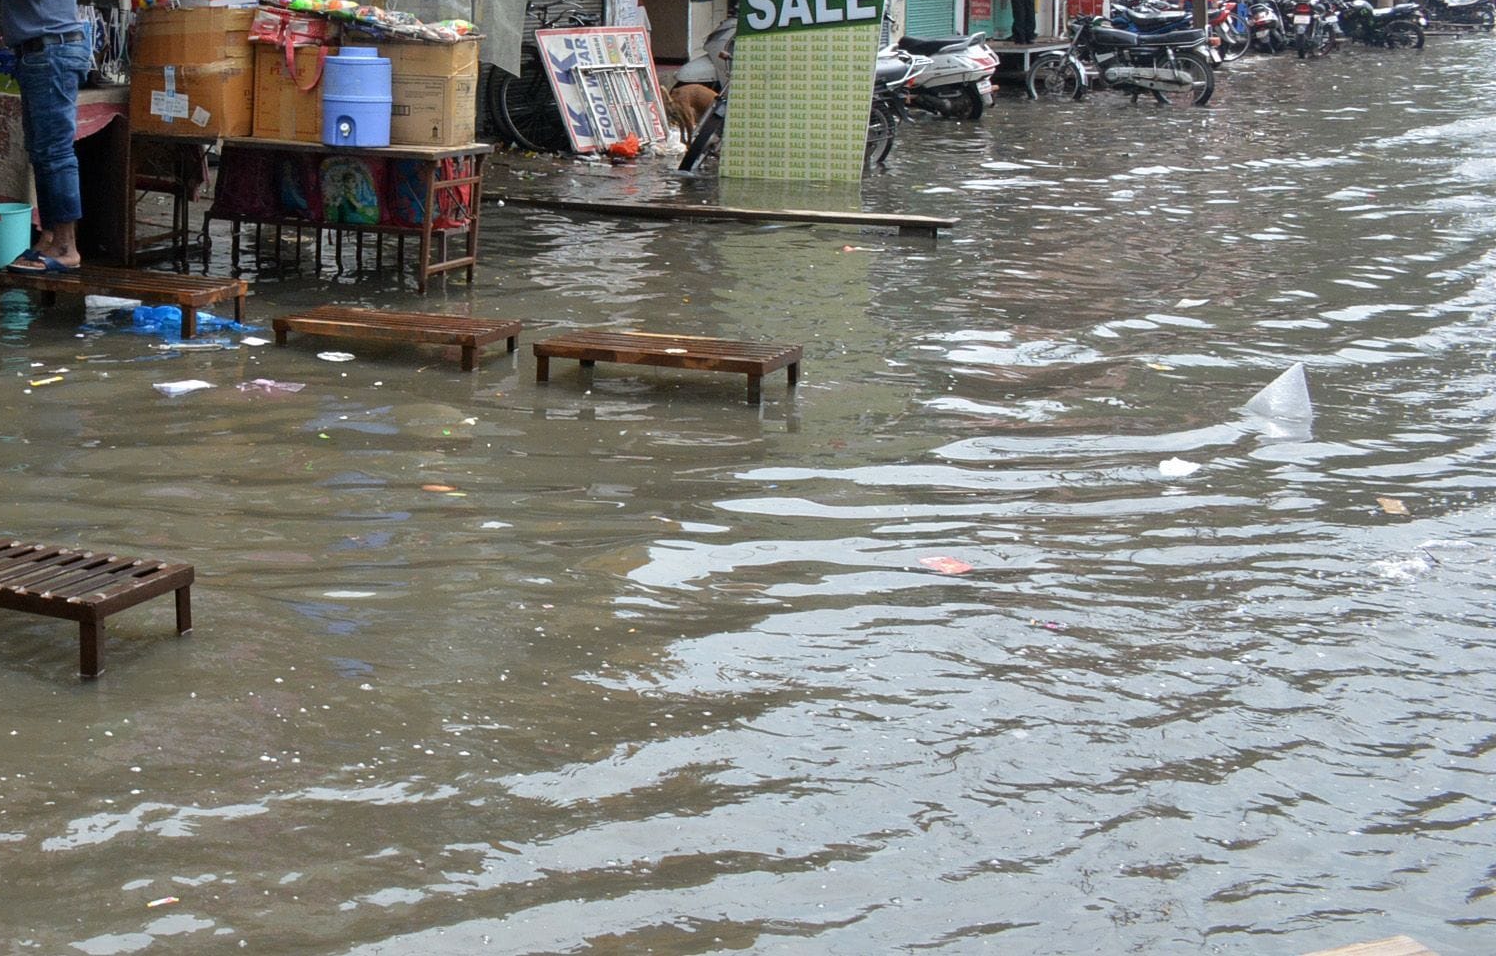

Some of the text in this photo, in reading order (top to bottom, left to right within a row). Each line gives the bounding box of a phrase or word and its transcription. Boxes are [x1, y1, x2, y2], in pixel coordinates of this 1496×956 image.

[575, 38, 616, 139] FOOT WAR
[649, 104, 665, 139] FILA
